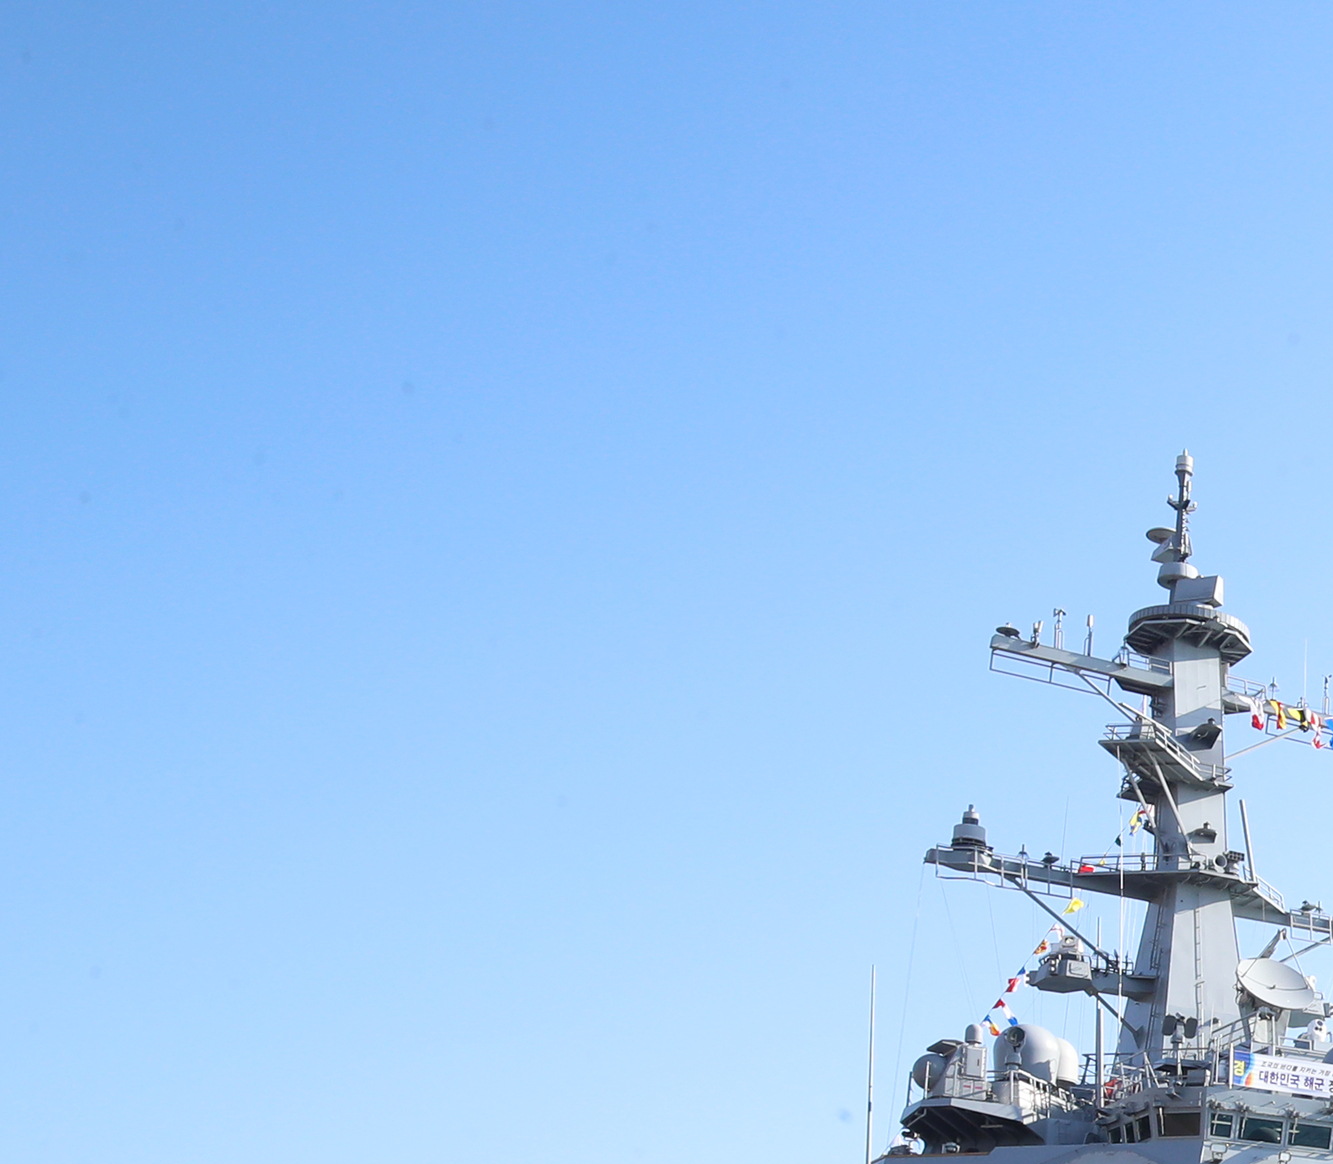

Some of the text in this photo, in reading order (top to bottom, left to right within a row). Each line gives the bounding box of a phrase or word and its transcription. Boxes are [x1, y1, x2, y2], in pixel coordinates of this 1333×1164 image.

[1234, 1060, 1245, 1077] 경
[1259, 1070, 1300, 1088] 대한민국
[1303, 1076, 1324, 1091] 해군
